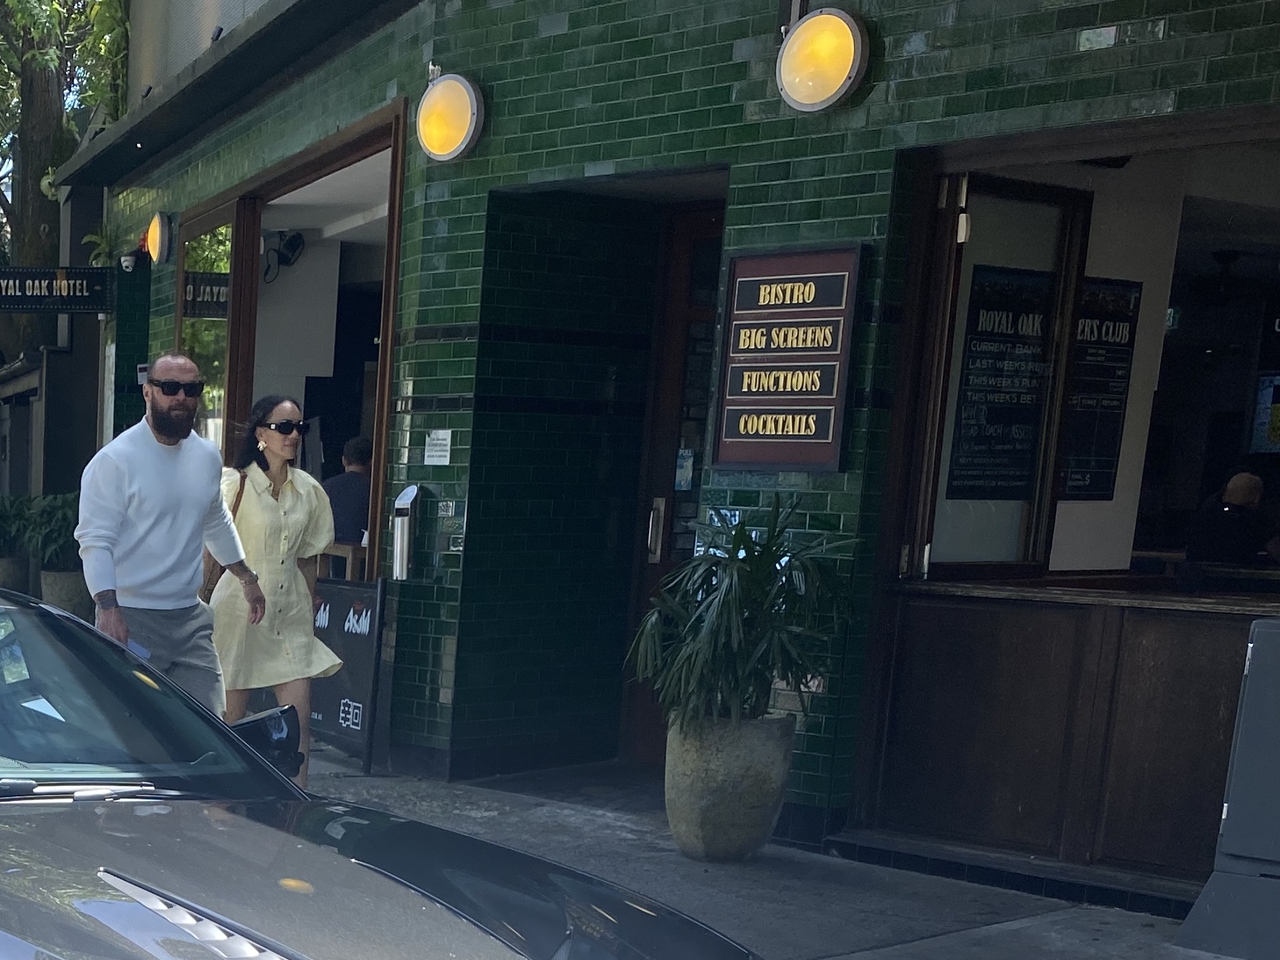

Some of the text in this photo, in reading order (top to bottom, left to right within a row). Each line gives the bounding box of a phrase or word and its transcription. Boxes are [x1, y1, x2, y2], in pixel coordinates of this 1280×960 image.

[25, 280, 49, 297] OAK
[52, 279, 90, 297] HOTEL
[758, 281, 816, 306] BISTRO
[738, 326, 833, 349] BIG SCREENS
[977, 309, 1015, 335] ROYAL
[1017, 313, 1044, 337] OAK
[1101, 321, 1130, 344] CLUB
[971, 340, 1013, 353] CURRENT
[969, 358, 994, 369] LAST
[742, 370, 821, 392] FUNCTIONS
[739, 414, 817, 436] COCKTAILS
